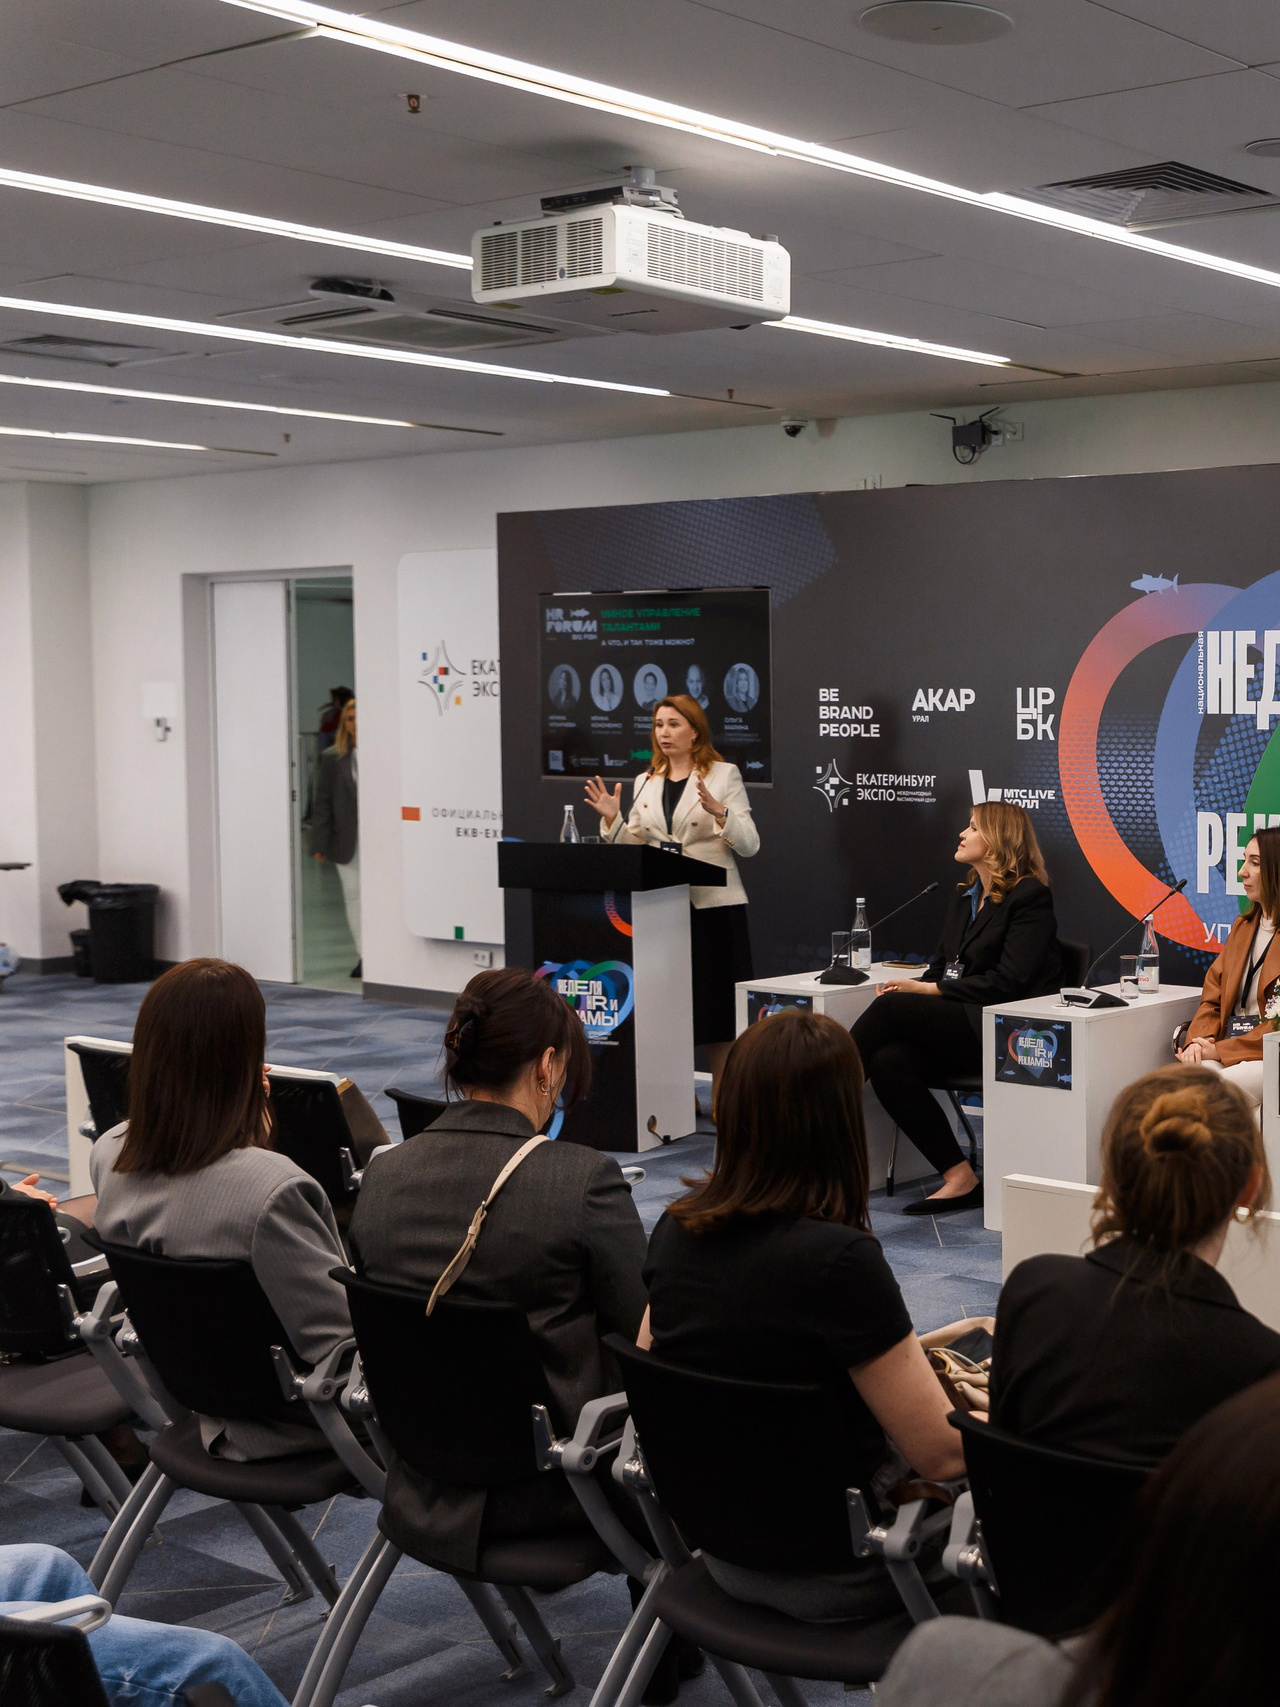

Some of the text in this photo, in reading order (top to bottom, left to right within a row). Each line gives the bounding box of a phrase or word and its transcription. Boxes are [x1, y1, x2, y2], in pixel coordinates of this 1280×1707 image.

[546, 608, 564, 620] HR
[818, 688, 840, 702] BE
[912, 688, 976, 712] АКАР
[818, 706, 874, 720] BRAND
[912, 715, 930, 723] УРАЛ
[819, 724, 880, 738] PEOPLE
[856, 773, 936, 788] ЕКАТЕРИНБУРГ
[856, 788, 896, 801] ЭКСПО
[1028, 789, 1056, 800] LIVE
